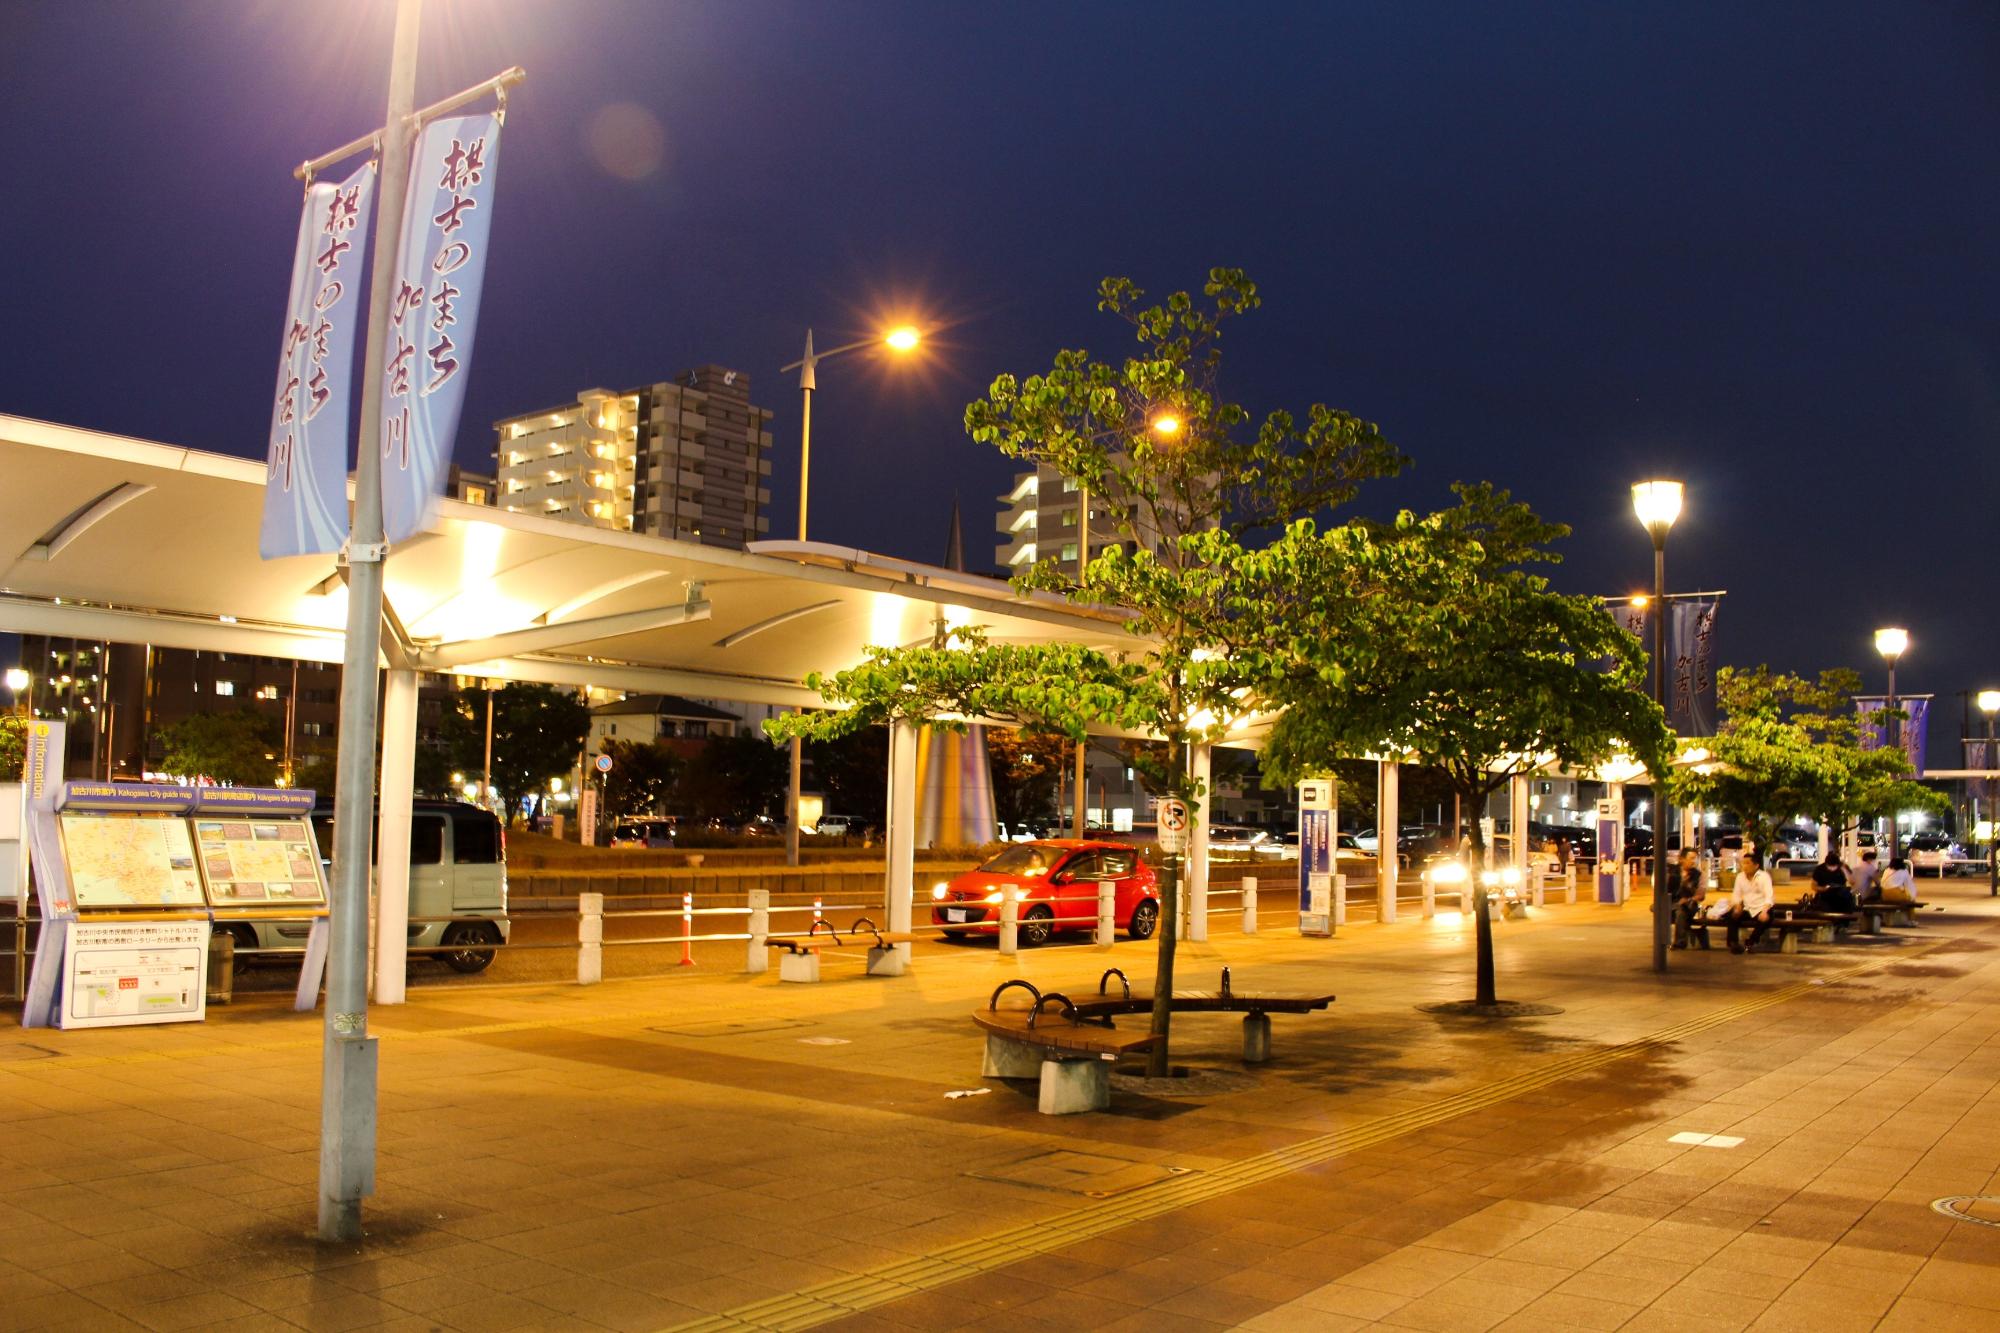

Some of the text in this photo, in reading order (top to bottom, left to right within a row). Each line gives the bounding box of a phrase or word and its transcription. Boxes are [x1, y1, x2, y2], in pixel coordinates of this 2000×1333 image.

[419, 137, 487, 398] 棋士のまち
[301, 184, 361, 425] 棋士のまち
[269, 318, 309, 493] 加古川
[384, 279, 426, 471] 加古川
[1674, 654, 1694, 715] 加古川
[34, 736, 48, 799] Information
[118, 788, 149, 798] Kakogawa
[150, 790, 161, 799] City
[162, 790, 178, 799] guide
[1321, 788, 1326, 801] 1
[1611, 804, 1618, 814] 2
